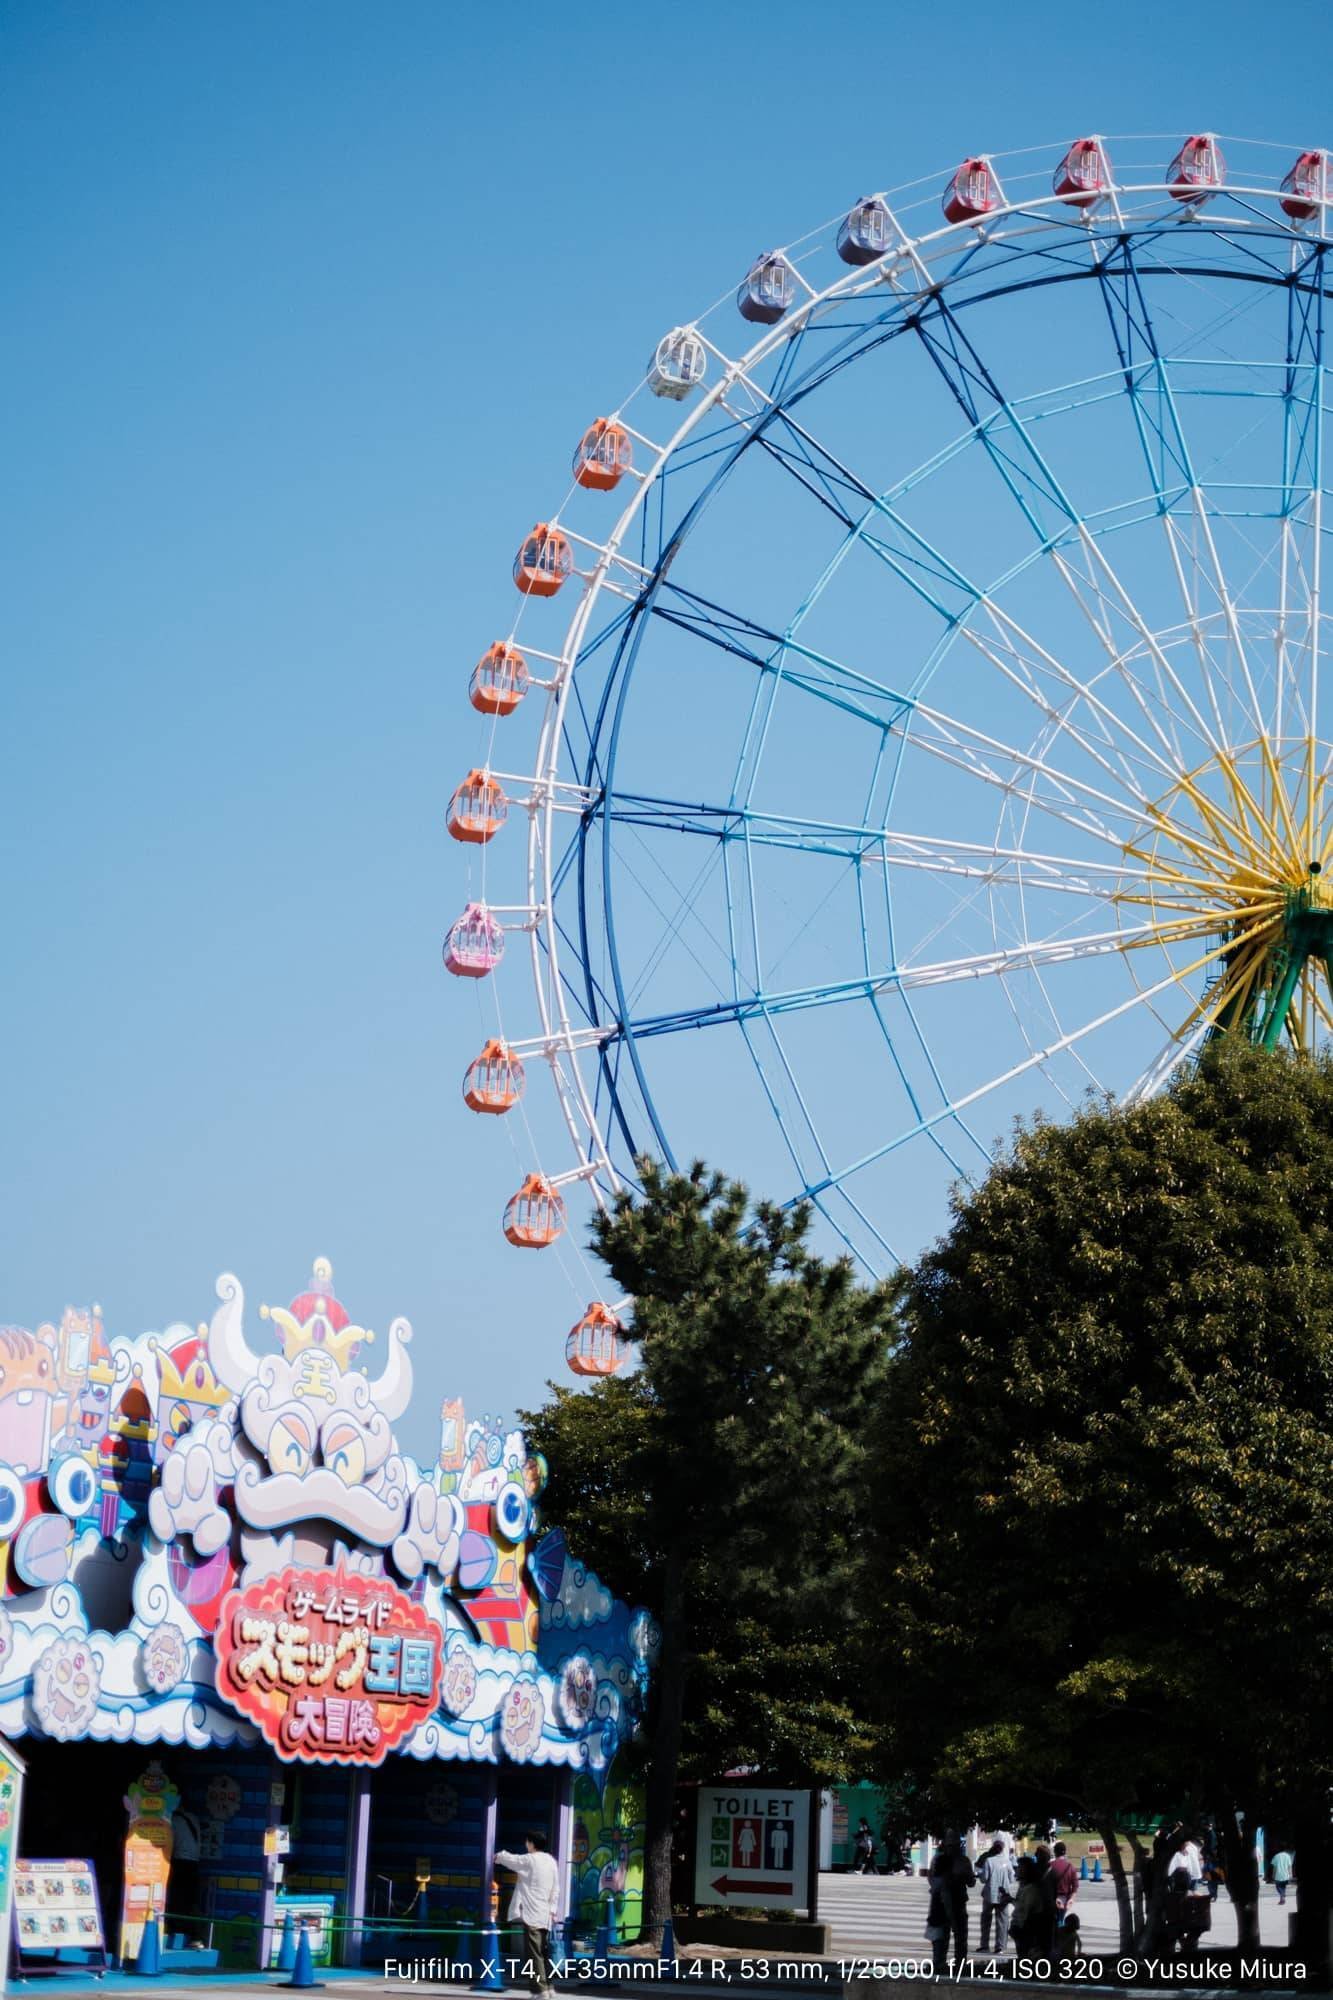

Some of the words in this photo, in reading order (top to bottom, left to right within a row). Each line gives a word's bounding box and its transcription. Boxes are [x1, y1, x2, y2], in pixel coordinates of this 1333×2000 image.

[293, 1590, 393, 1629] ゲームライド
[237, 1617, 436, 1697] スモッグ王国
[288, 1696, 381, 1747] 大冒険
[713, 1796, 794, 1817] TOILET
